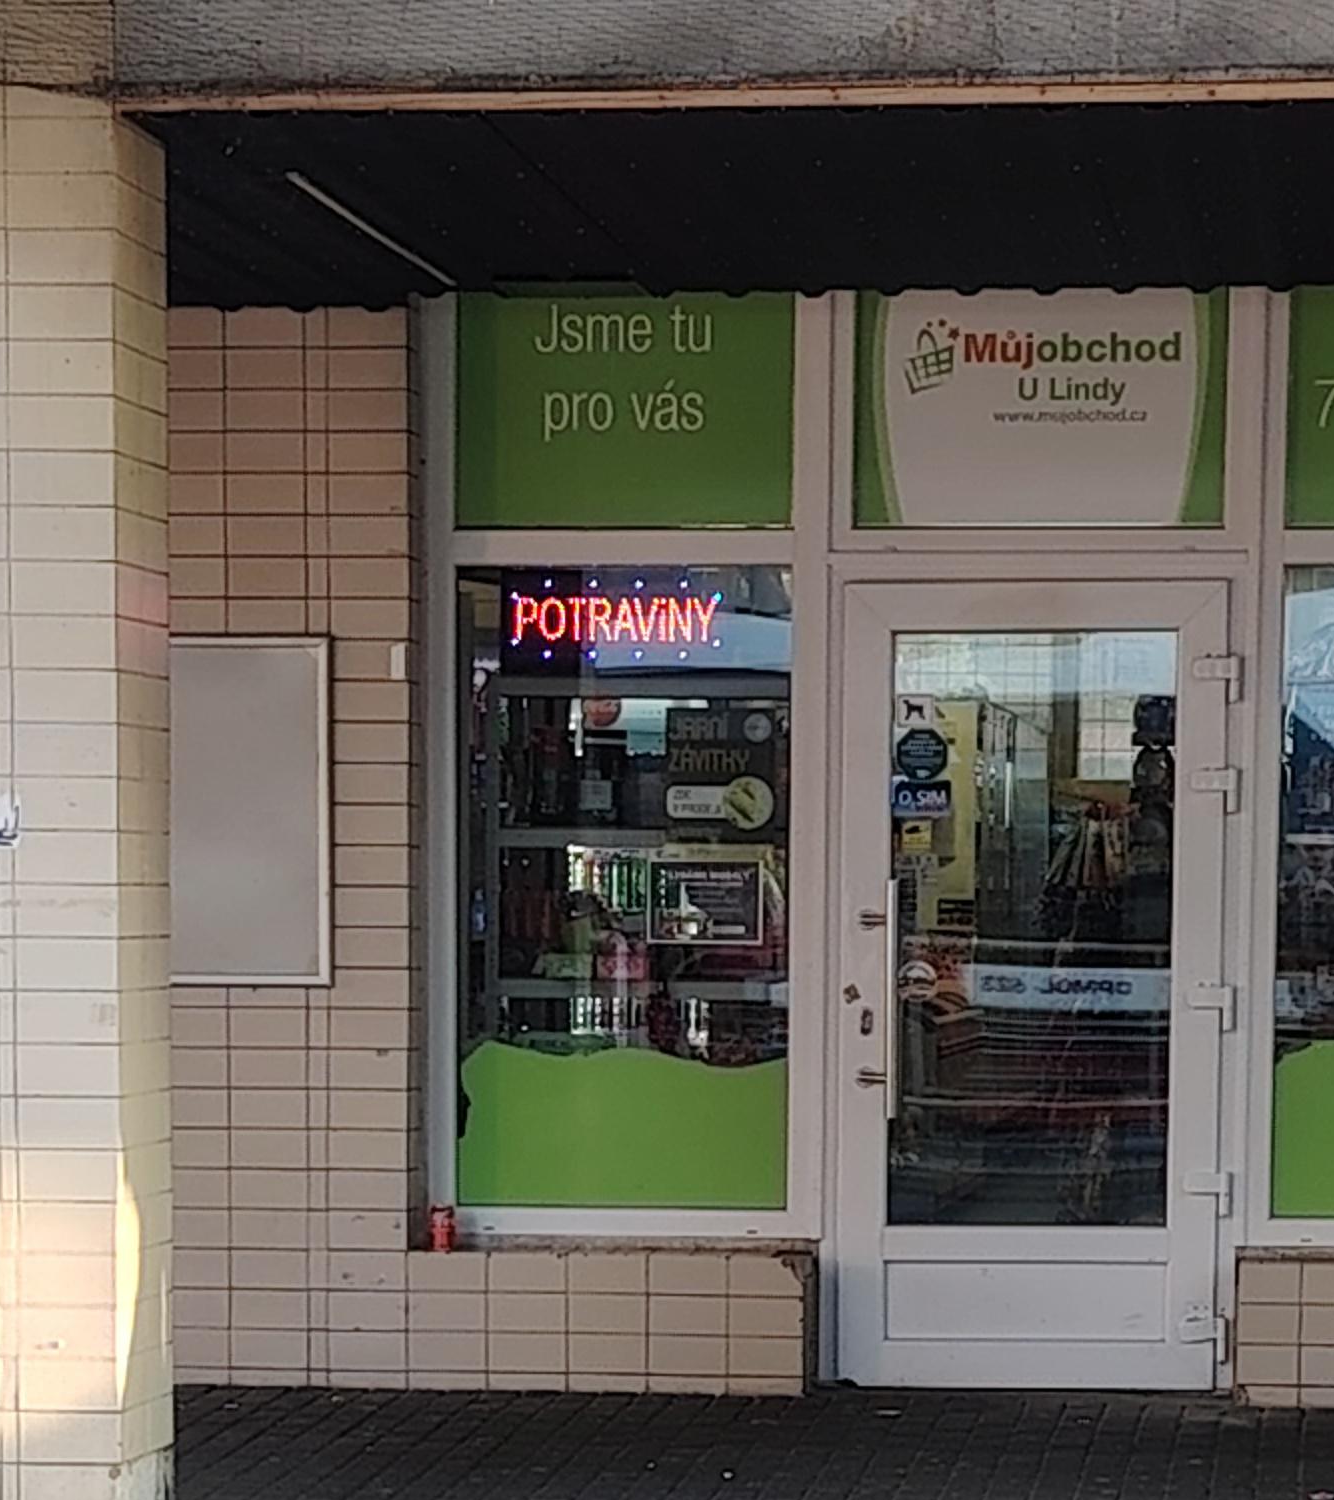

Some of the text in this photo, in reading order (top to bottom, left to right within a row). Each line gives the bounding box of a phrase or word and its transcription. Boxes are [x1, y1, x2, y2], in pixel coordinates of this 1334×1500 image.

[534, 303, 712, 353] Jsme tu
[963, 329, 1182, 371] Můjobchod
[543, 379, 704, 443] pro vás
[1017, 375, 1127, 407] U Lindy
